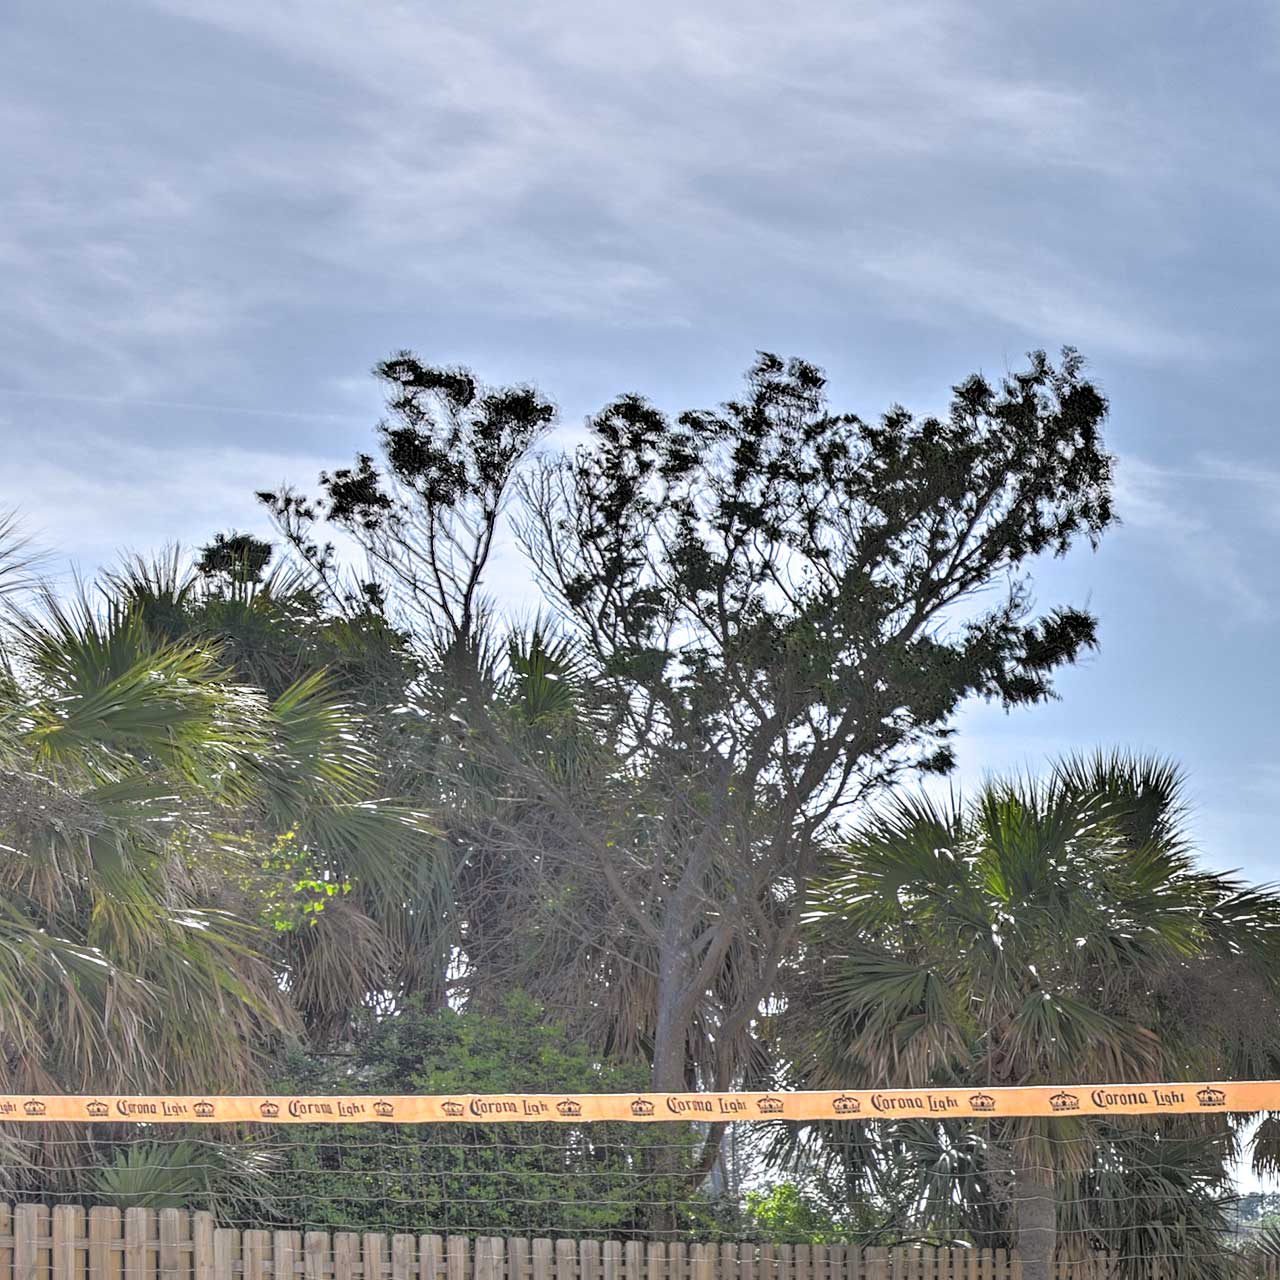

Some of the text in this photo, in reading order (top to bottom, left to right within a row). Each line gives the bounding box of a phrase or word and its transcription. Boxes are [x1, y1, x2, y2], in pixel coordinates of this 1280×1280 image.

[116, 1099, 188, 1117] Corona Light
[288, 1099, 365, 1119] Corona Light
[470, 1098, 518, 1118] Corona
[666, 1095, 747, 1116] Corona Light
[871, 1093, 960, 1116] Corona Light
[1091, 1088, 1185, 1111] Corona Light
